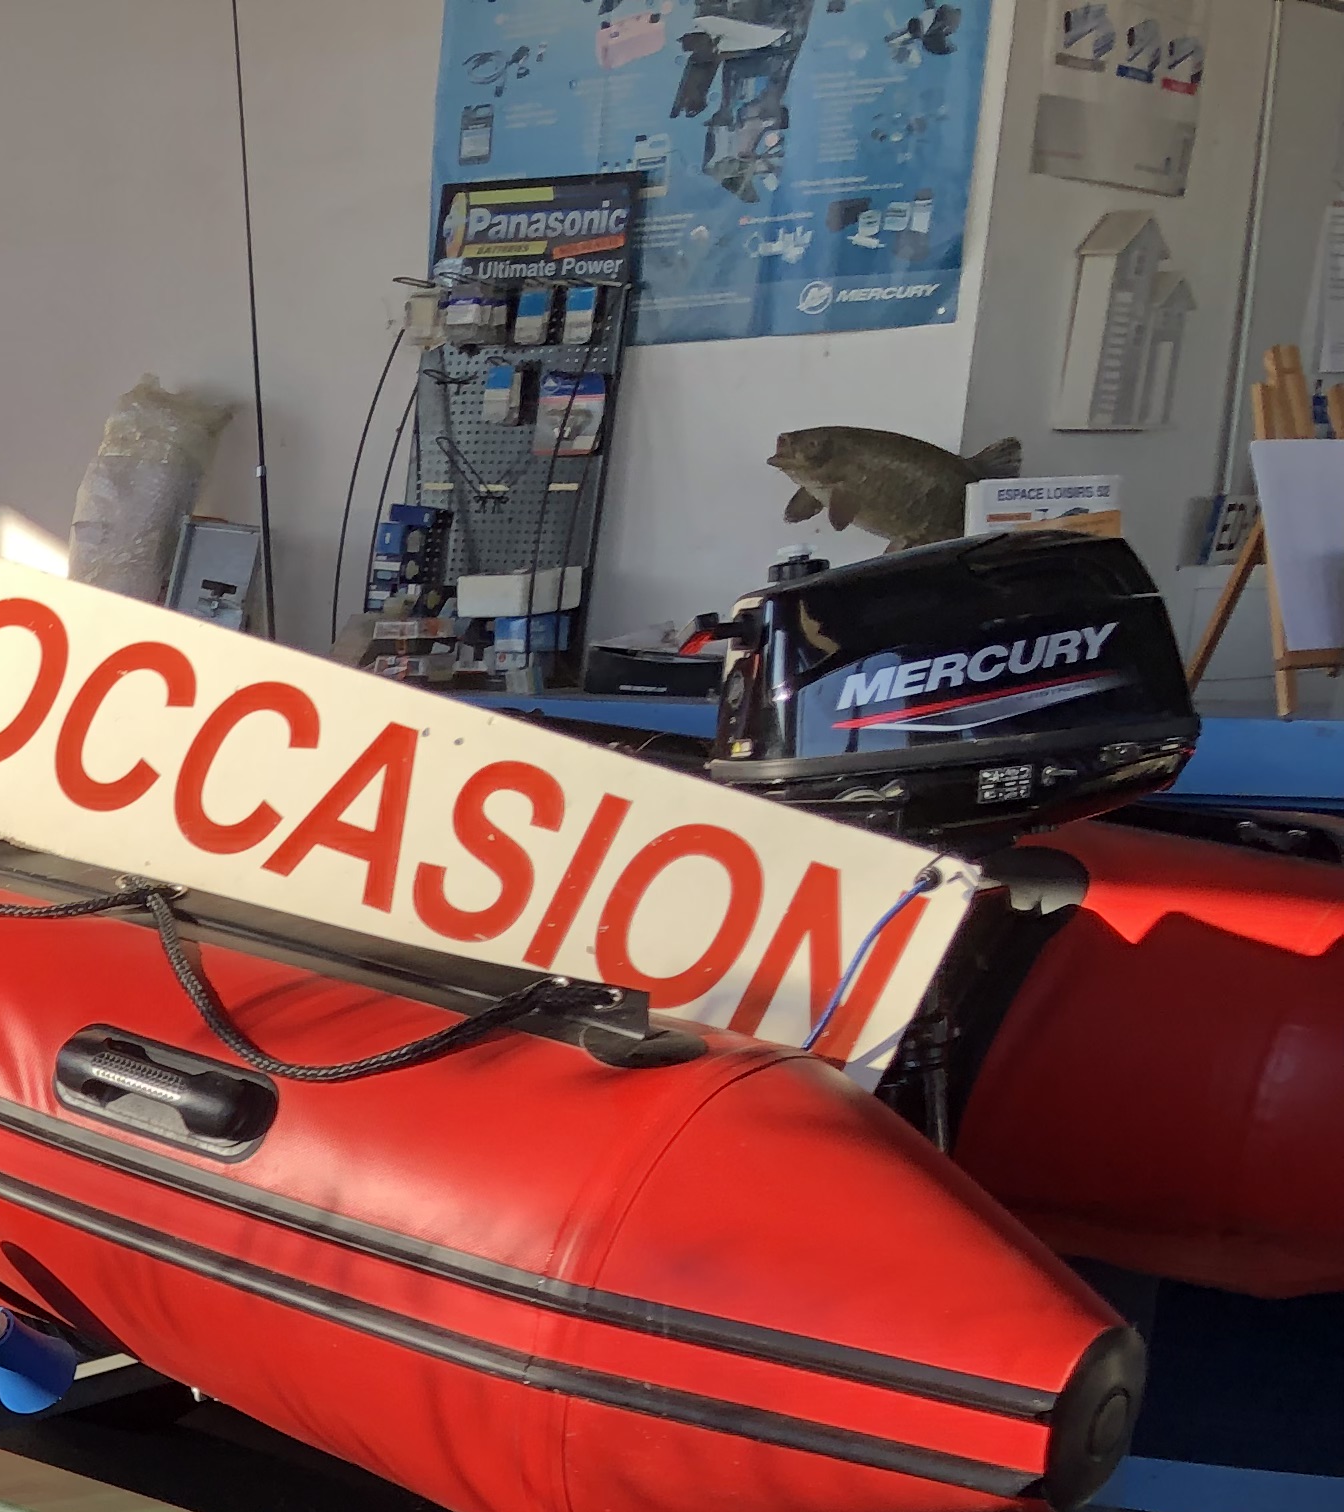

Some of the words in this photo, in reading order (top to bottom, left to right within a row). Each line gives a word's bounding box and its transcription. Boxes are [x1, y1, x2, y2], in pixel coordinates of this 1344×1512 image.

[466, 200, 627, 242] Panasonic
[478, 259, 557, 280] Ultimate
[561, 257, 624, 276] Power
[836, 283, 941, 303] MERCURY
[997, 487, 1044, 501] ESPACE
[835, 621, 1120, 712] MERCURY
